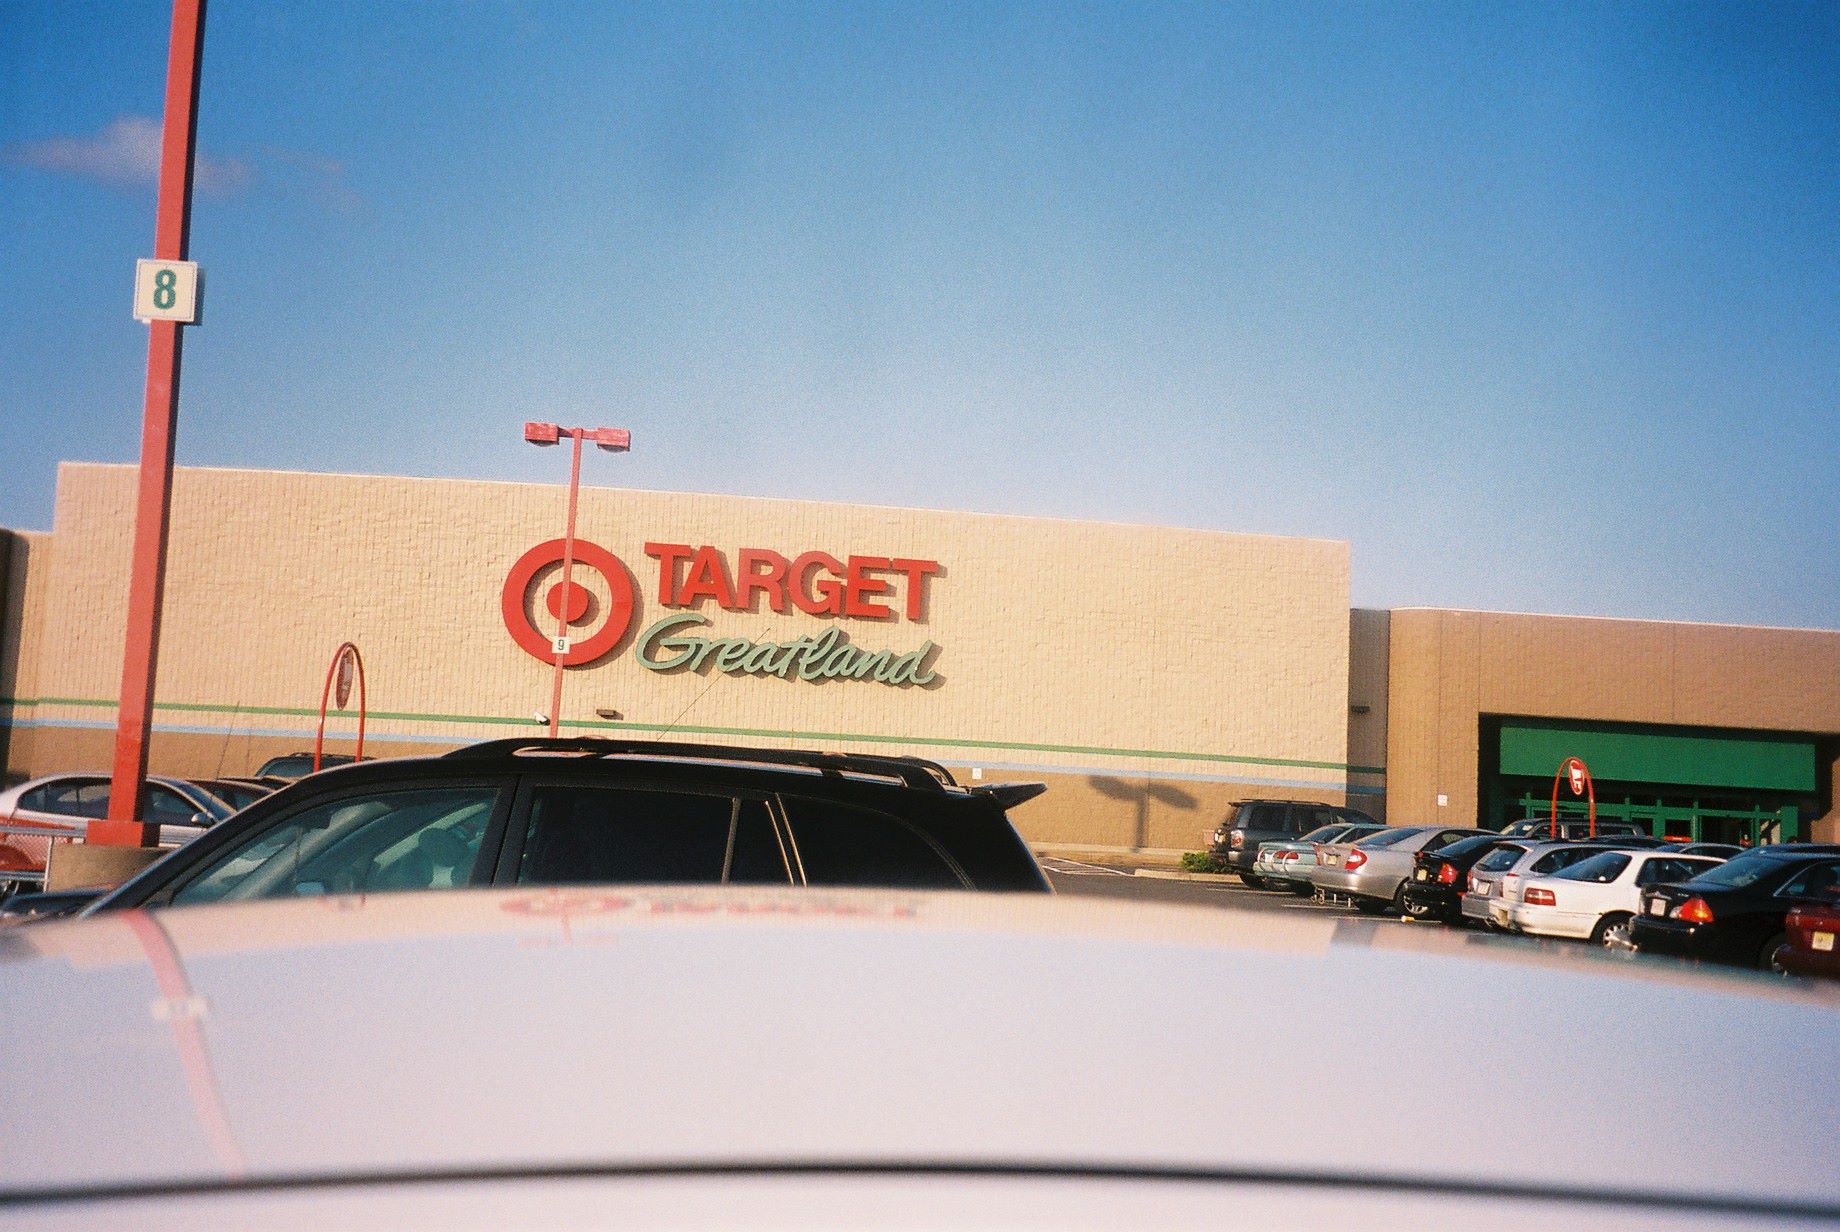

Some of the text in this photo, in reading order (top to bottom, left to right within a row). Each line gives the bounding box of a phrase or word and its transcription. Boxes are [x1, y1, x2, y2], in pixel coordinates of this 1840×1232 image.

[153, 269, 176, 309] 8
[644, 542, 938, 620] TARGET
[558, 639, 565, 651] 9
[635, 614, 937, 685] Greatland
